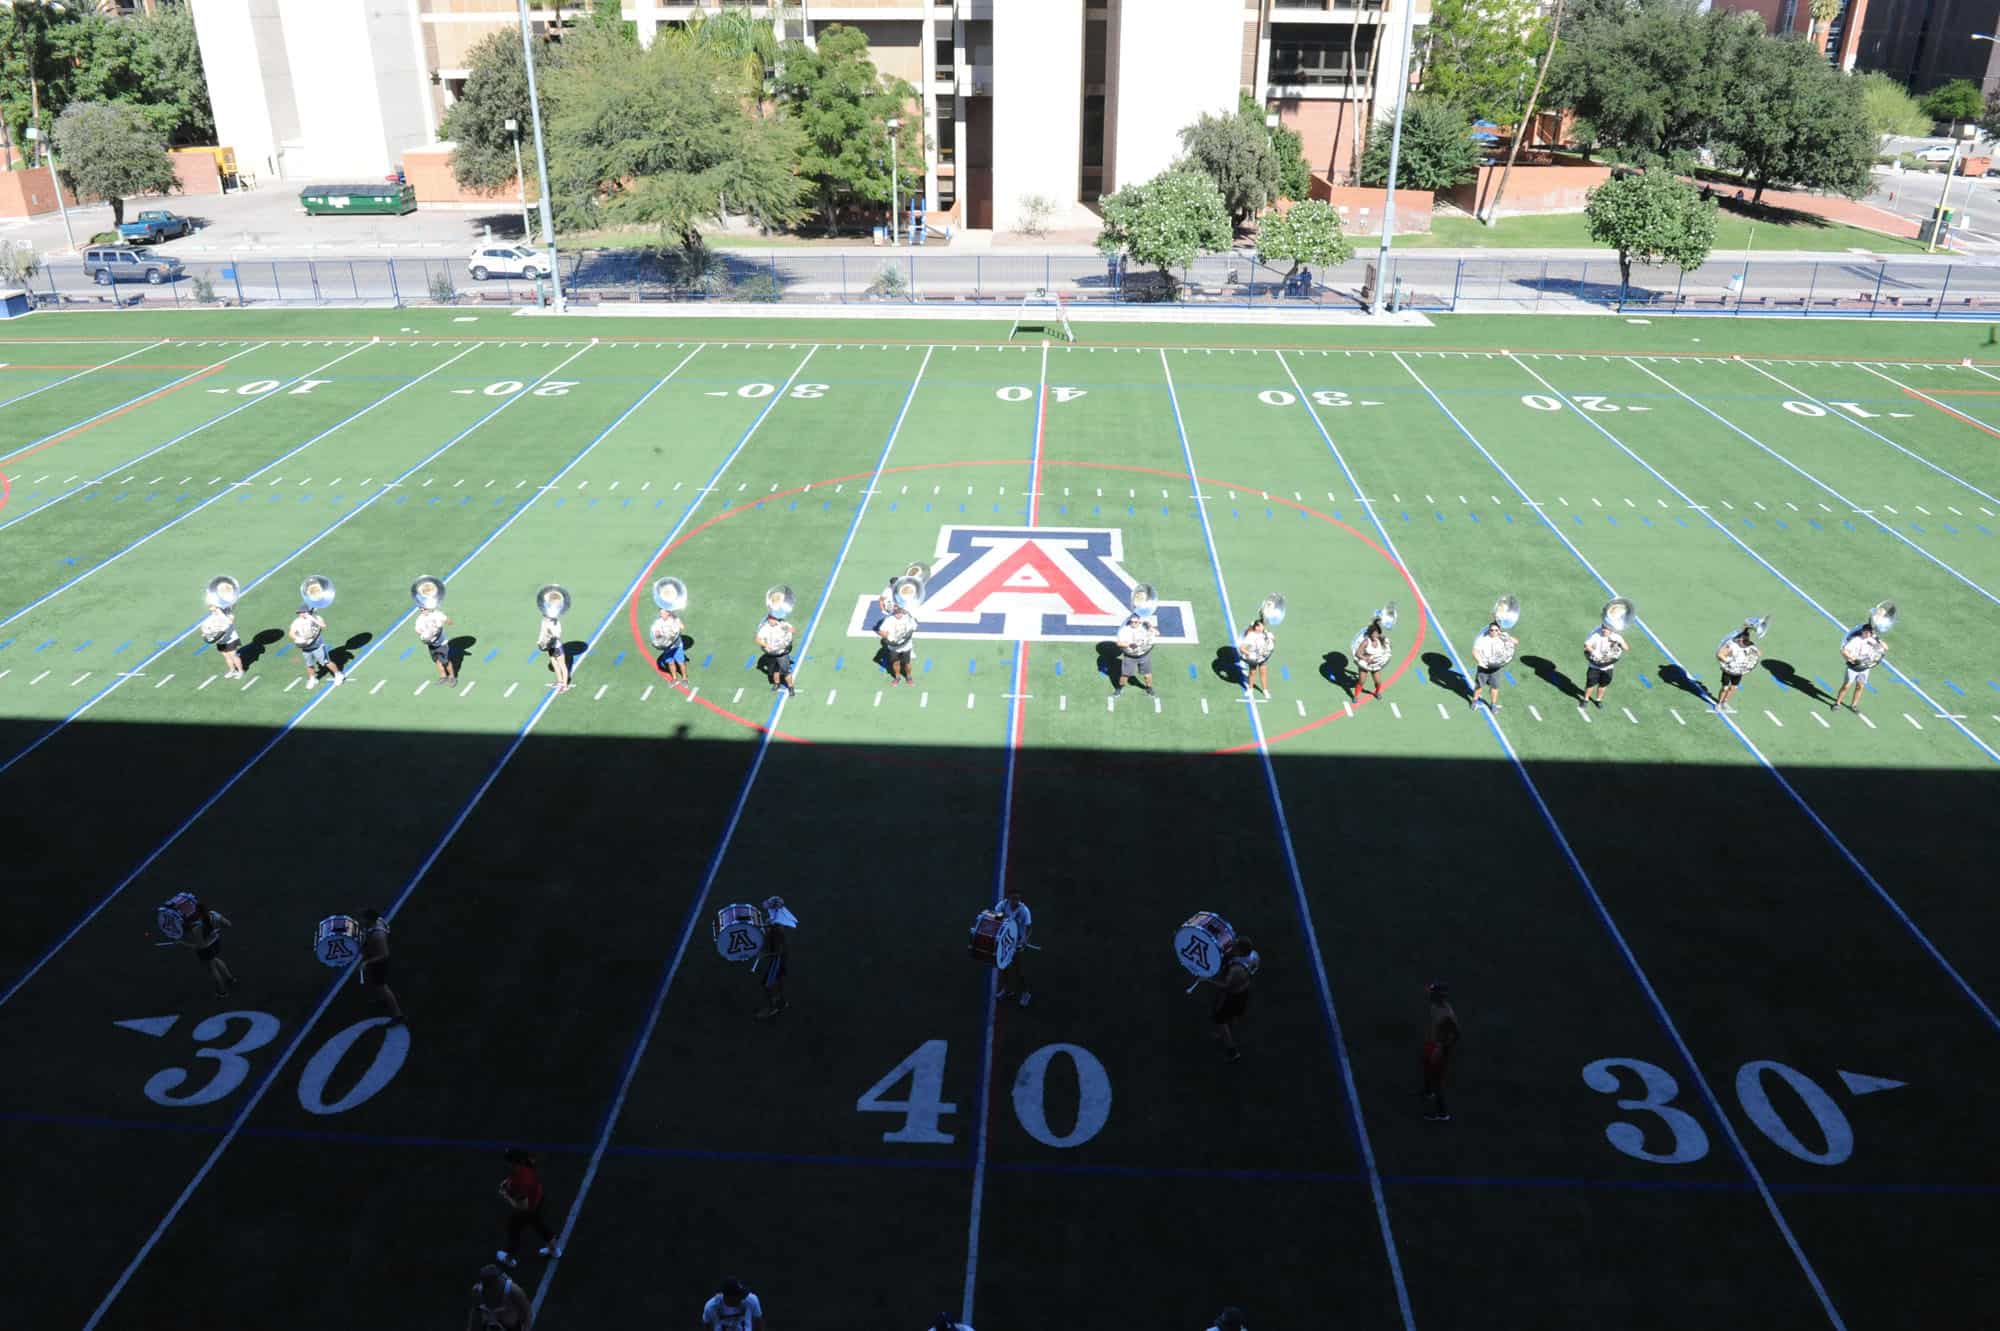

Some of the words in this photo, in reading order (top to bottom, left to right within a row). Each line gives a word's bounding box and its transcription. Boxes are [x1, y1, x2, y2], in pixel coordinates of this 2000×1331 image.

[236, 380, 333, 395] 10
[483, 381, 580, 396] 20
[736, 383, 830, 398] 30
[995, 386, 1088, 402] 40
[1257, 390, 1352, 406] 30
[1521, 395, 1620, 411] 20
[1781, 401, 1880, 417] 10
[846, 524, 1199, 644] A
[326, 938, 353, 961] A
[728, 929, 756, 954] A
[1182, 935, 1210, 970] A
[143, 1010, 412, 1116] 30
[856, 1039, 1113, 1148] 40
[1581, 1056, 1855, 1167] 30
